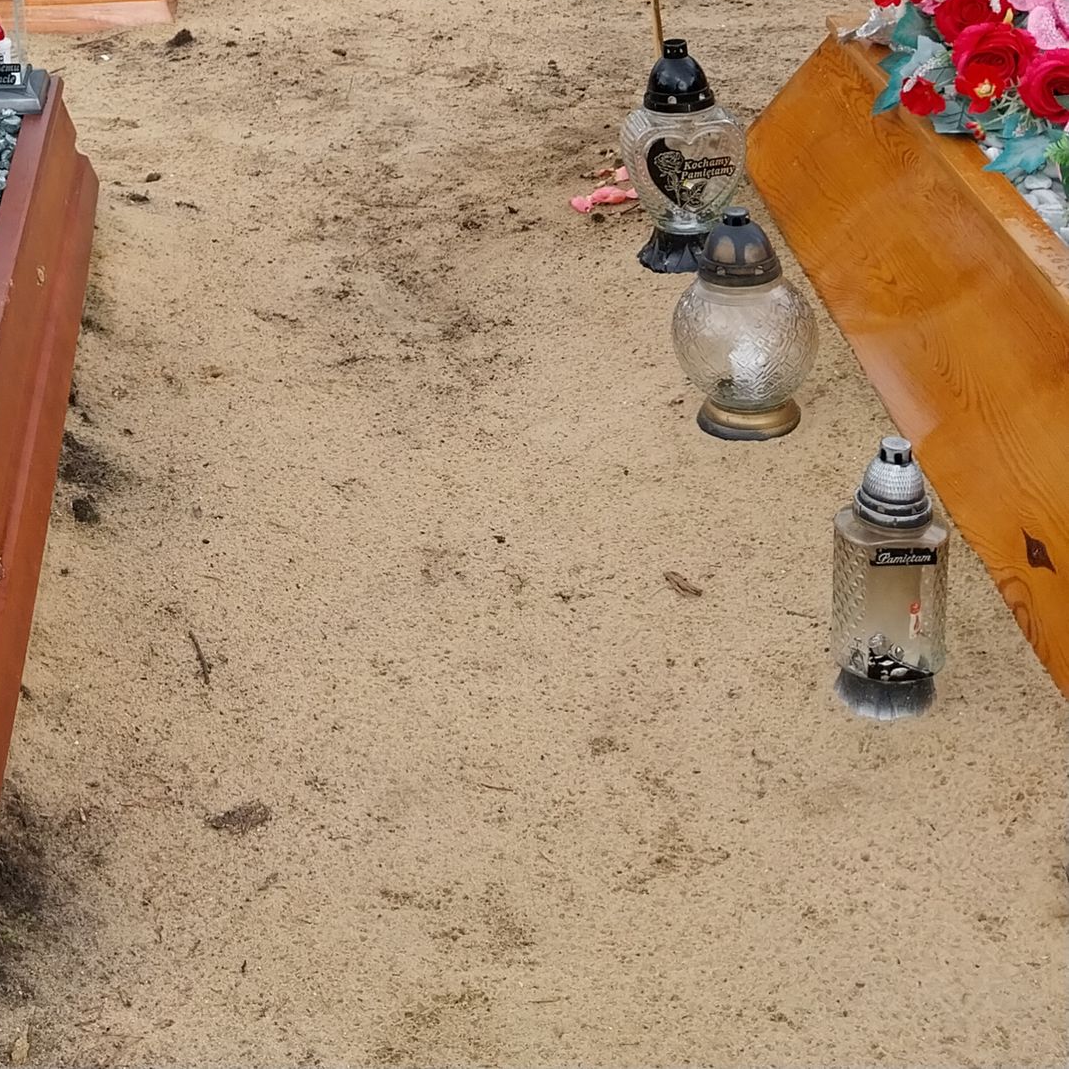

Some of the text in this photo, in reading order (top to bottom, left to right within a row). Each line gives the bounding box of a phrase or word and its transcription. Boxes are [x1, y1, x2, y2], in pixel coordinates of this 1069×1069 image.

[684, 157, 730, 170] Kochamy
[681, 166, 735, 180] Pamiętamy
[876, 552, 932, 566] Pamiętam
